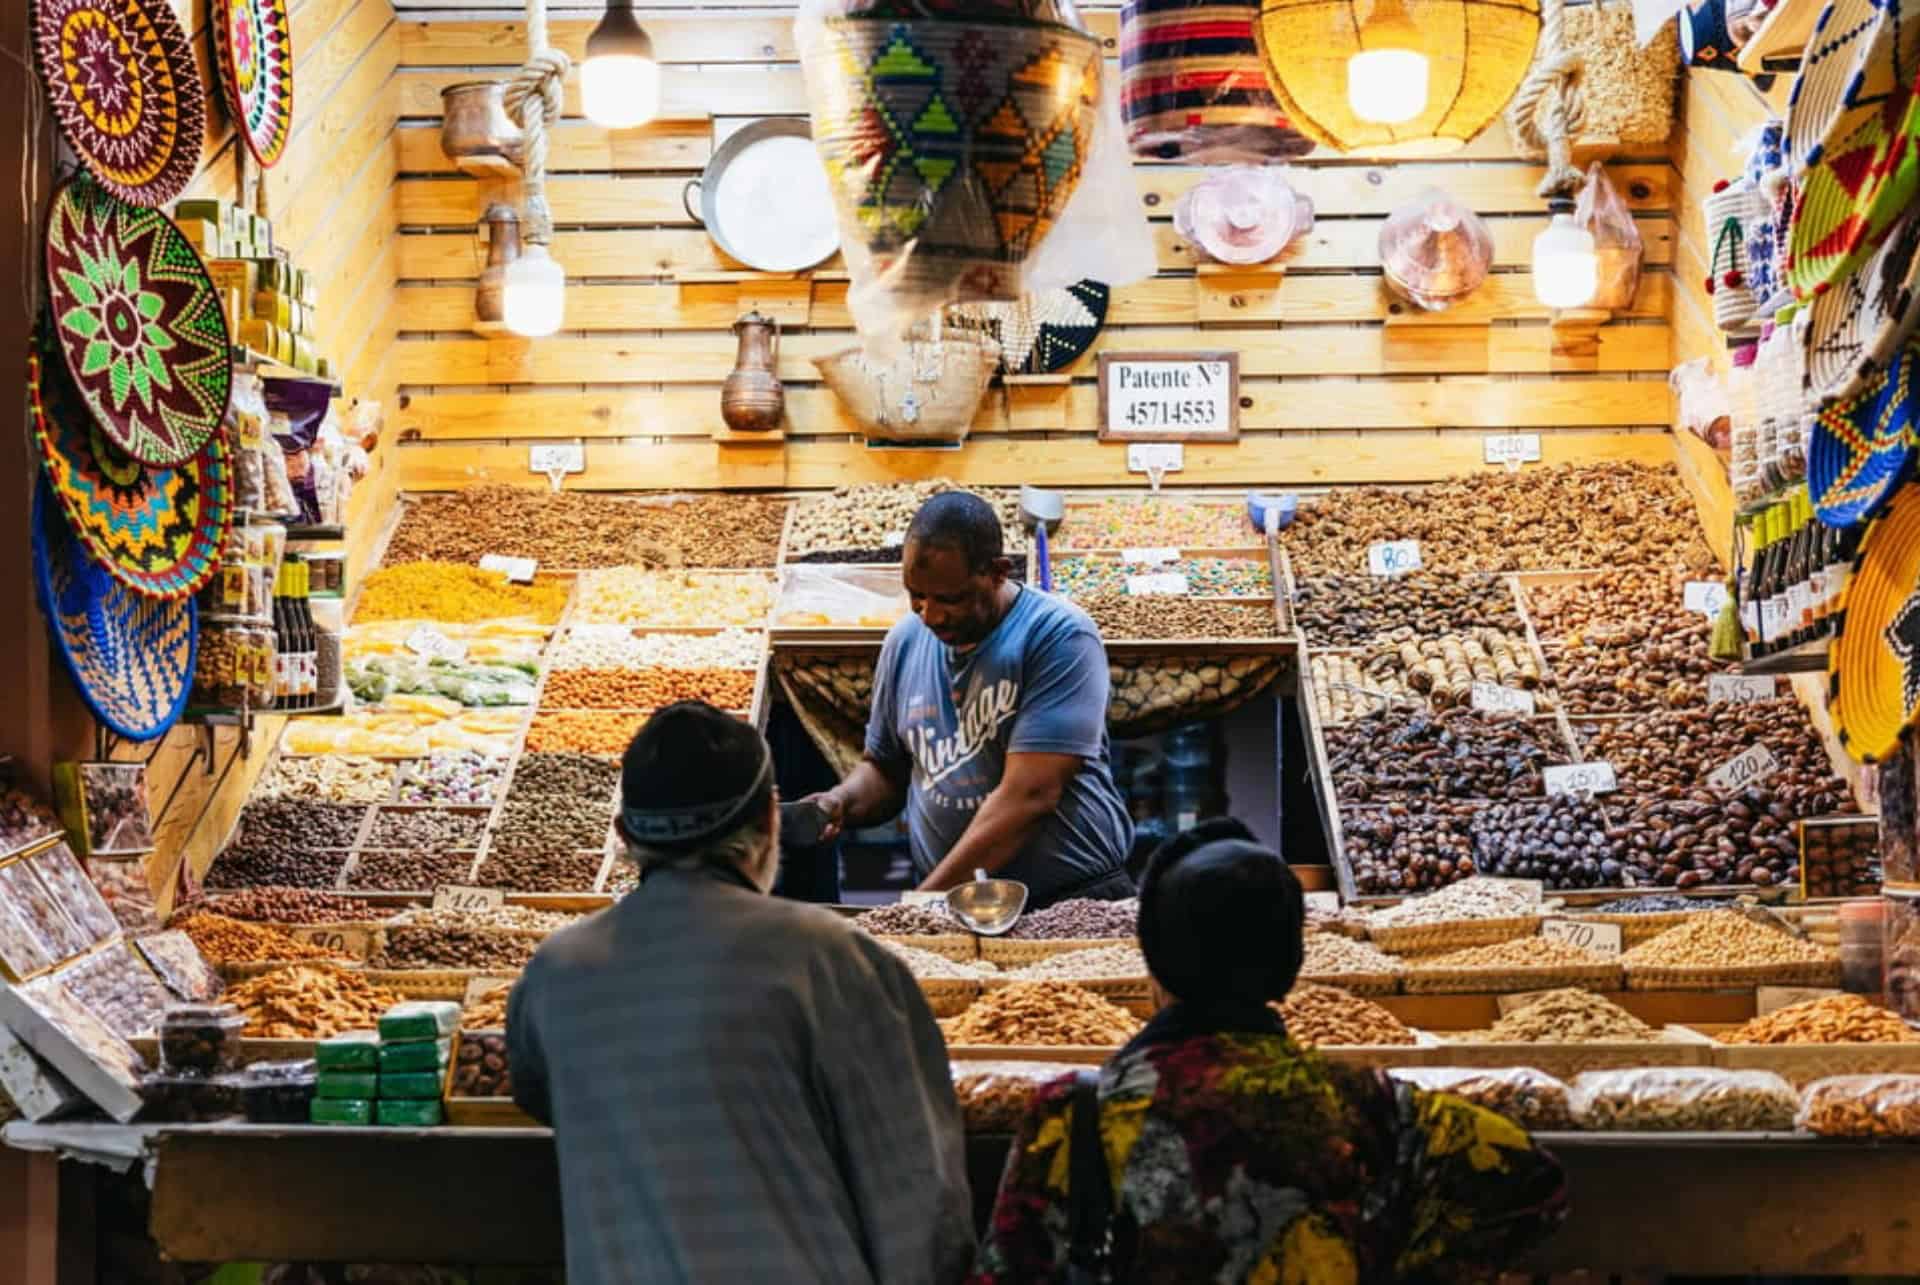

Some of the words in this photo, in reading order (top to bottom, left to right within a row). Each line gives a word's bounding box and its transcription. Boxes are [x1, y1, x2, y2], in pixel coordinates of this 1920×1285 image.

[1119, 366, 1190, 388] Patente
[1126, 400, 1215, 425] 45714553
[1381, 545, 1409, 570] 80
[906, 675, 1018, 790] Vintage
[1727, 755, 1759, 786] 120
[1565, 923, 1595, 950] 70
